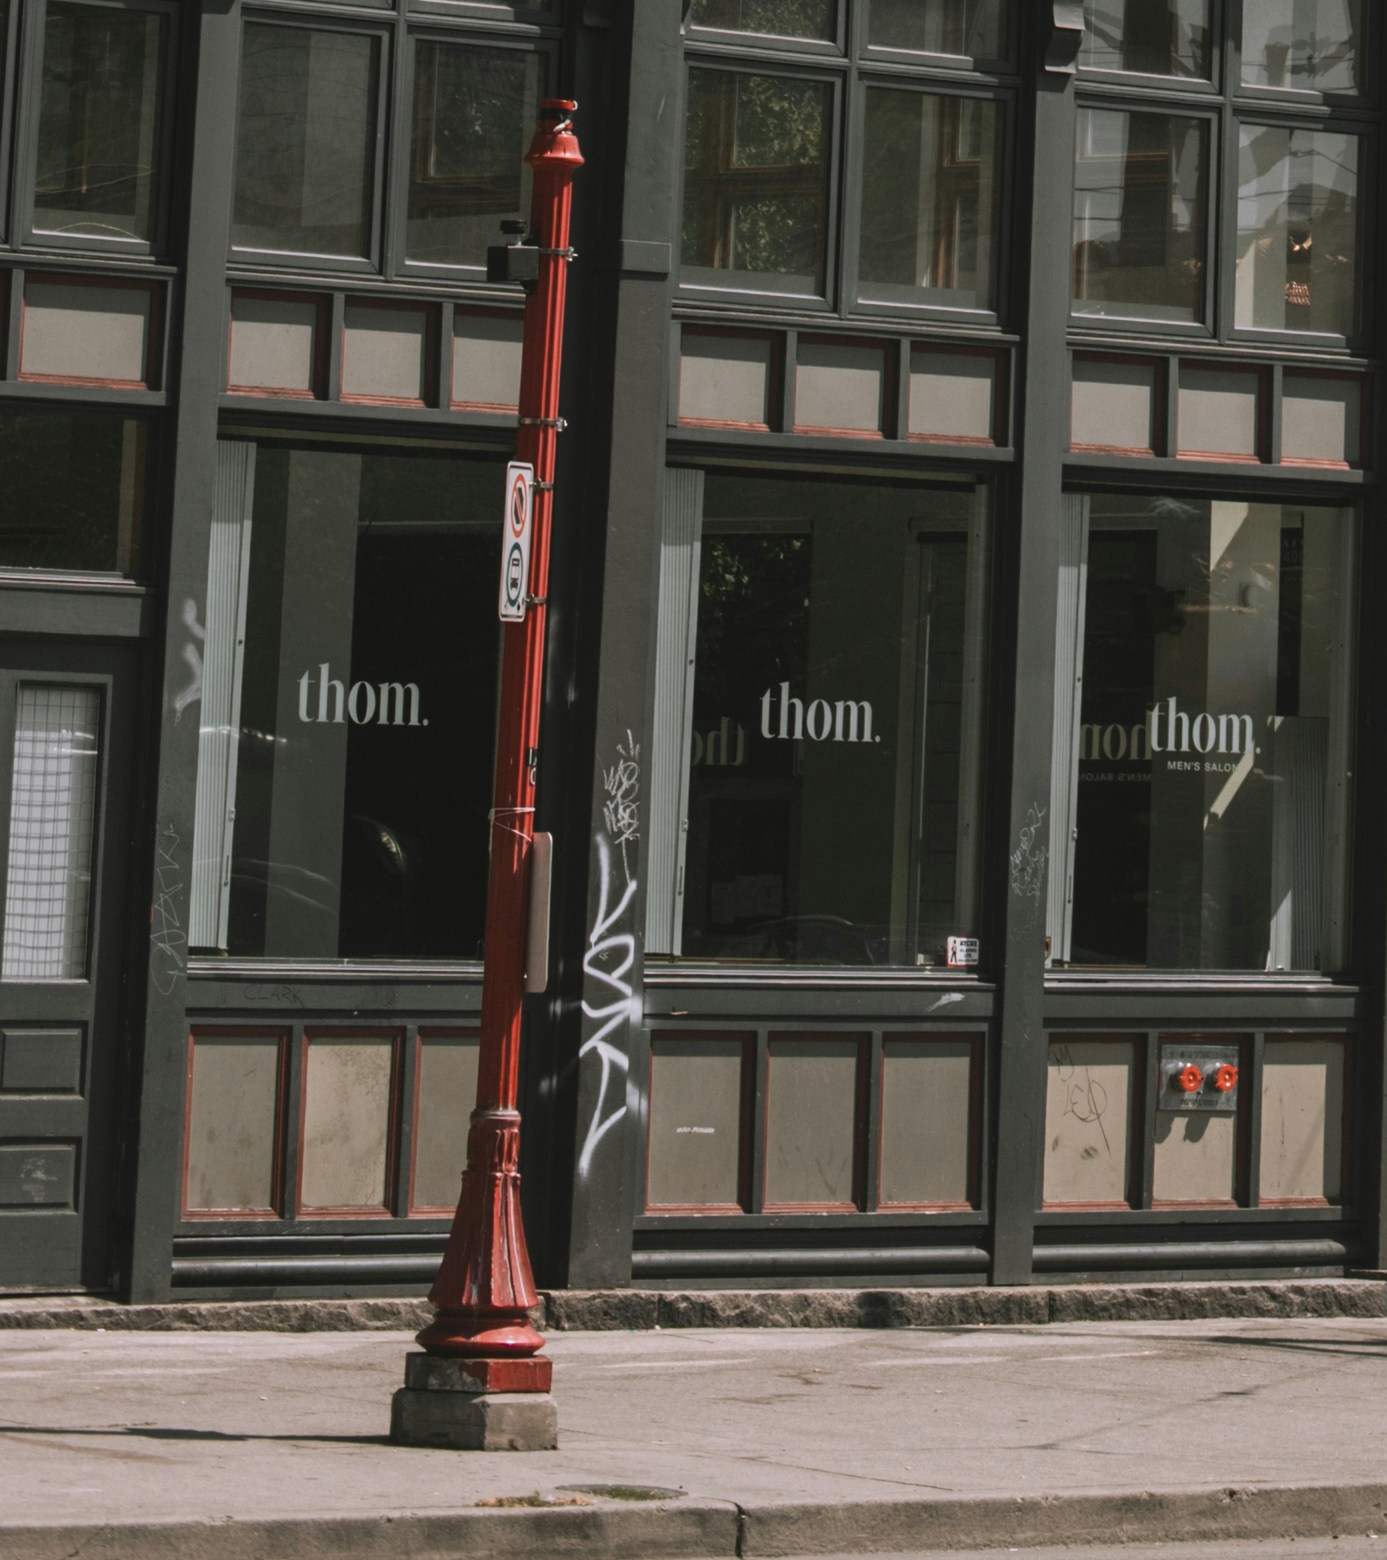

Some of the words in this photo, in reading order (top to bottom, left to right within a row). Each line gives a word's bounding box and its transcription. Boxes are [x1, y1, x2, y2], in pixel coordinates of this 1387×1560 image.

[297, 662, 429, 726] thom.
[759, 681, 881, 743] thom.
[1147, 696, 1261, 754] thom.
[1167, 760, 1200, 771] MEN'S
[1204, 762, 1238, 773] SALON
